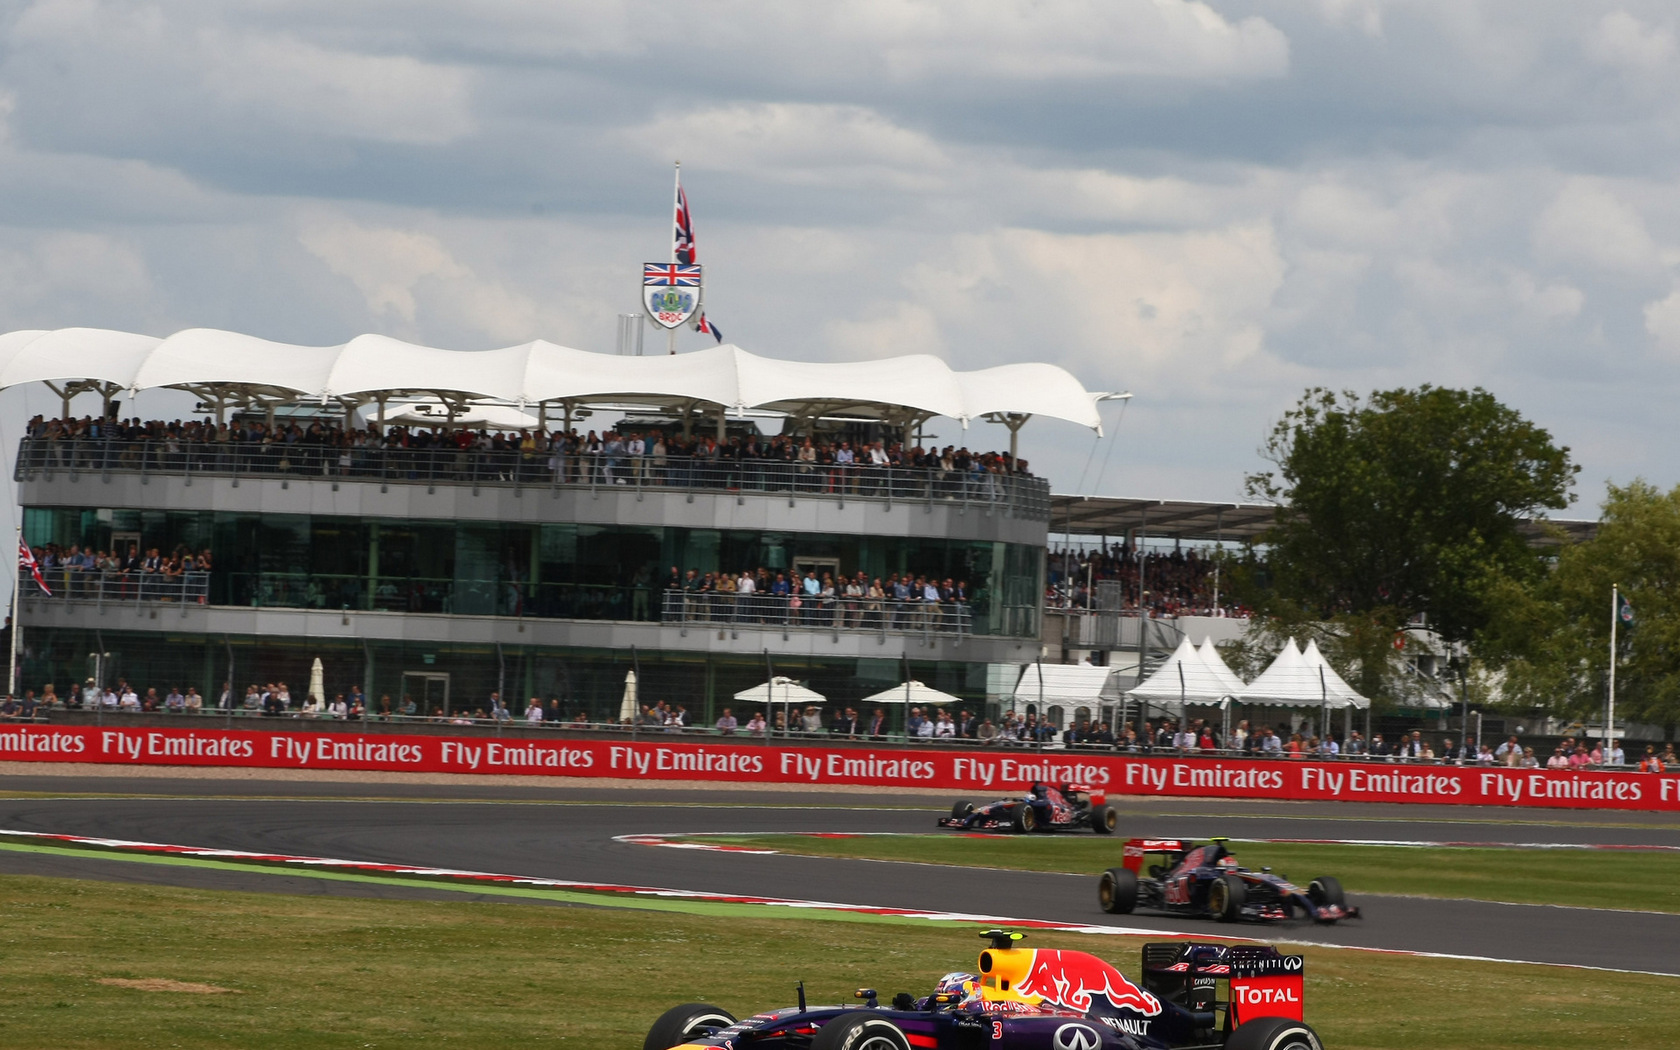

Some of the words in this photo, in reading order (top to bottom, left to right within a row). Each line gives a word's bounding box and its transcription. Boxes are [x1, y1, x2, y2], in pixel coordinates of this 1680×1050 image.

[103, 731, 142, 759] Fly
[148, 732, 253, 758] Emirates
[271, 736, 310, 764] Fly
[316, 737, 422, 763] Emirates
[441, 741, 481, 769] Fly
[487, 742, 593, 768] Emirates
[610, 746, 650, 774] Fly
[656, 748, 763, 773] Emirates
[780, 752, 821, 780] Fly
[827, 753, 935, 779] Emirates
[953, 758, 995, 786] Fly
[1001, 759, 1110, 784] Emirates
[1126, 763, 1168, 790] Fly
[1174, 764, 1283, 789] Emirates
[1301, 768, 1343, 795] Fly
[1349, 769, 1461, 795] Emirates
[1480, 774, 1523, 802] Fly
[1529, 774, 1642, 800] Emirates
[992, 1021, 1003, 1039] 3
[1100, 1016, 1152, 1036] RENAULT
